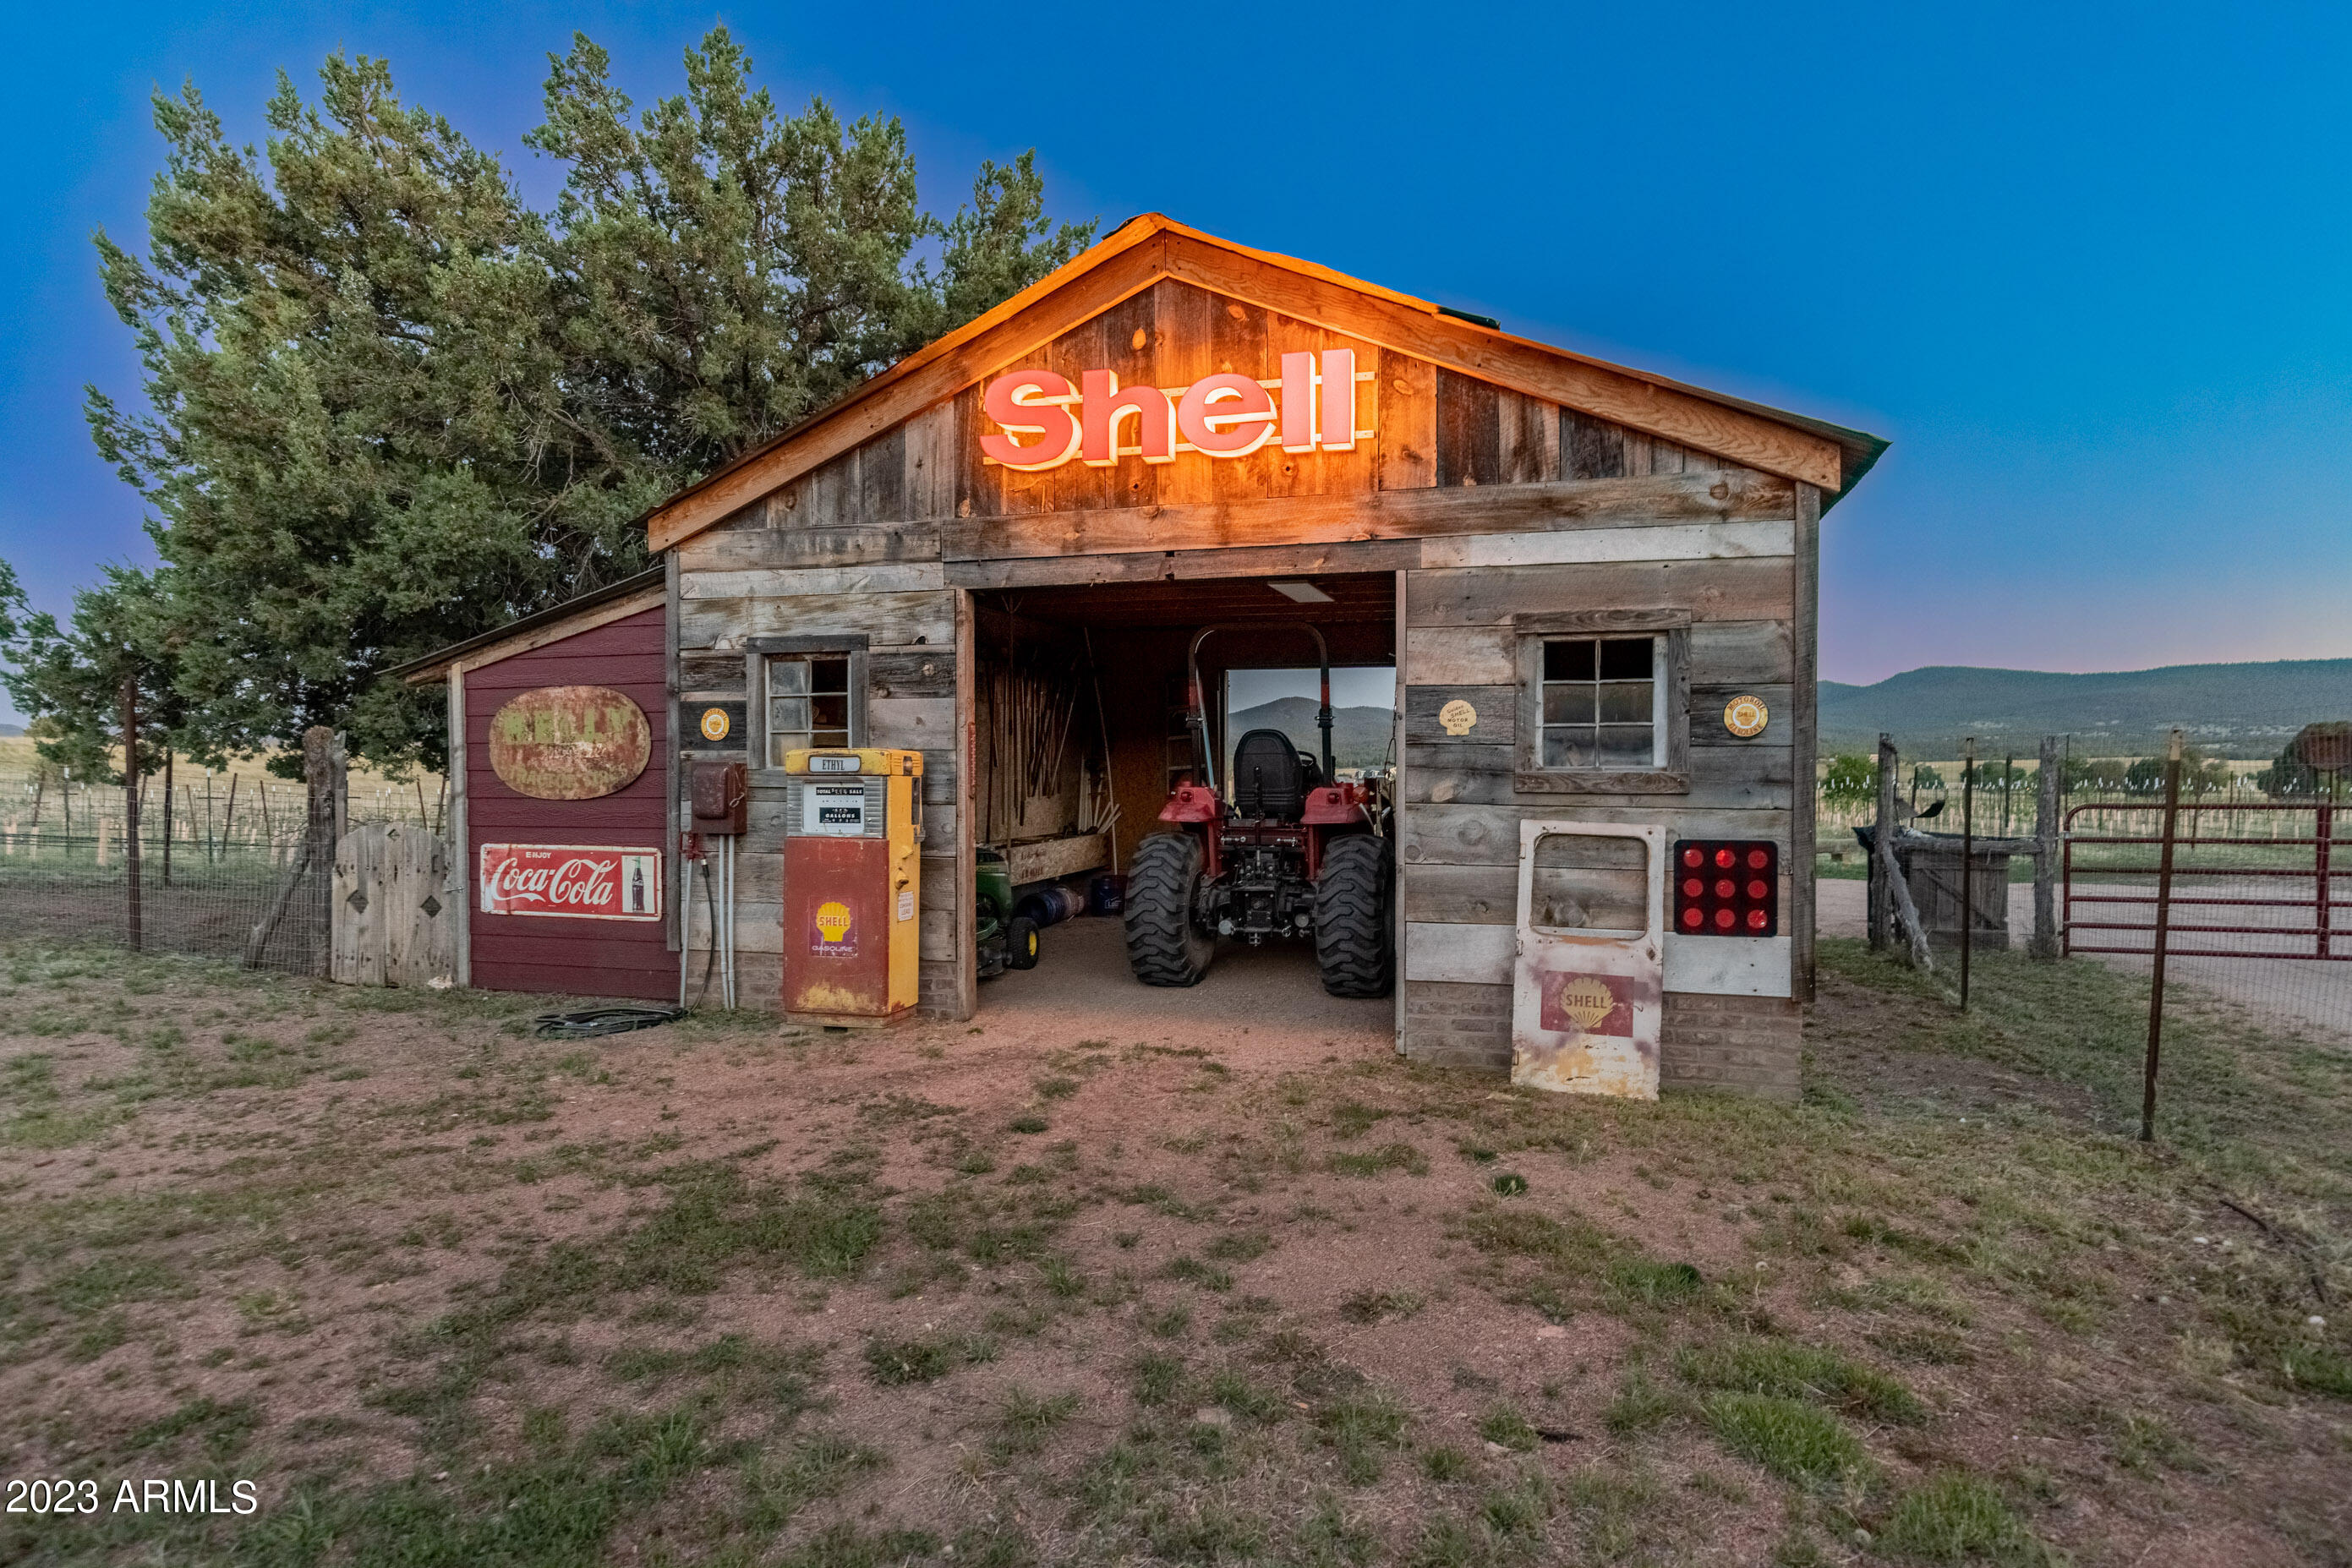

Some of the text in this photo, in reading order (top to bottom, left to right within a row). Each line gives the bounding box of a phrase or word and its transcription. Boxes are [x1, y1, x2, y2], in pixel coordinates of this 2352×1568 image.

[979, 348, 1356, 472] Shell
[1451, 709, 1469, 718] SHELL
[822, 759, 845, 771] ETHYL
[490, 857, 619, 906] Coca-Cola
[818, 916, 849, 926] SHELL
[1566, 994, 1606, 1008] SHELL
